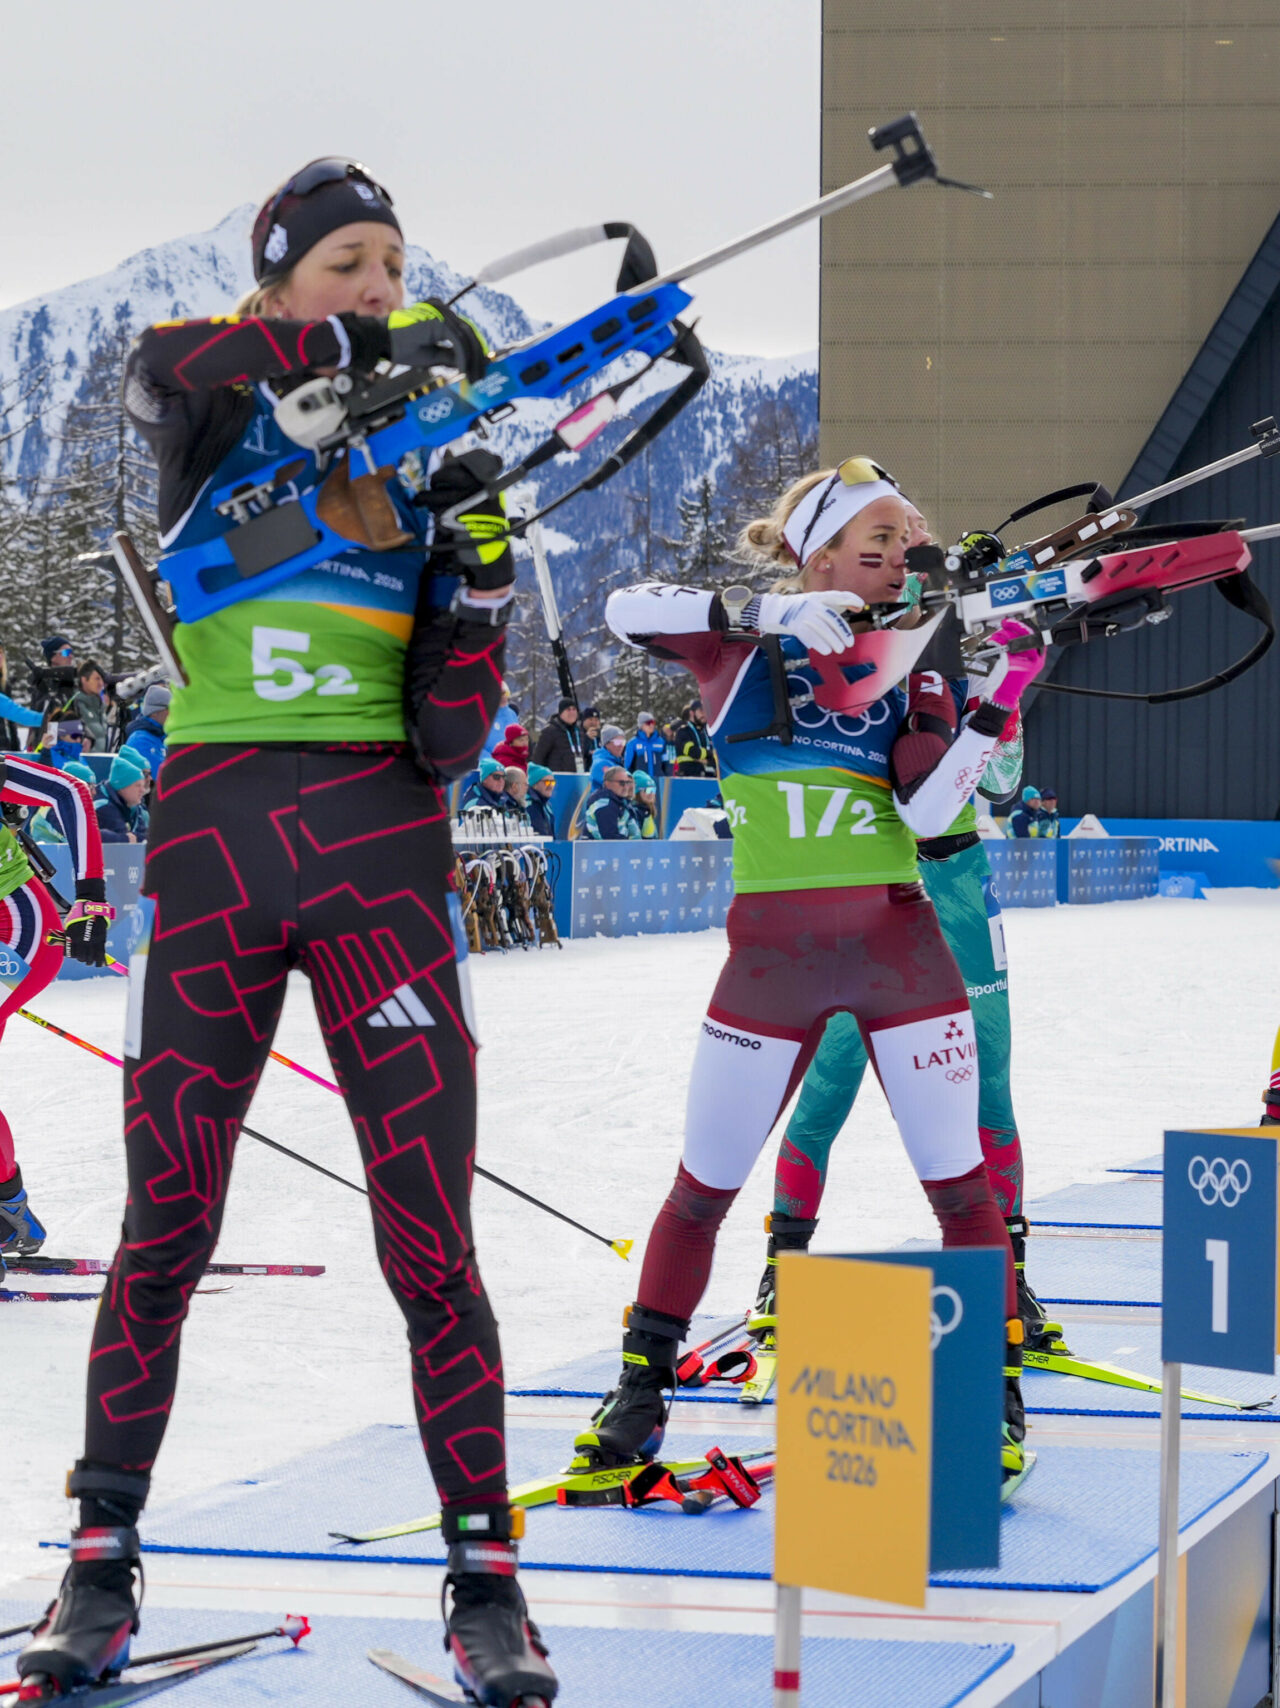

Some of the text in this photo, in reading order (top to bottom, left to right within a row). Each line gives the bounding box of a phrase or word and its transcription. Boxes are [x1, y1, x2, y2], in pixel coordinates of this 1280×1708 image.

[813, 738, 866, 759] CORTINA
[1206, 1238, 1229, 1334] 1
[1022, 1352, 1050, 1365] SCHER
[790, 1366, 896, 1409] MILANO
[807, 1406, 918, 1454] CORTINA
[591, 1471, 632, 1486] FISCHER
[826, 1449, 877, 1488] 2026
